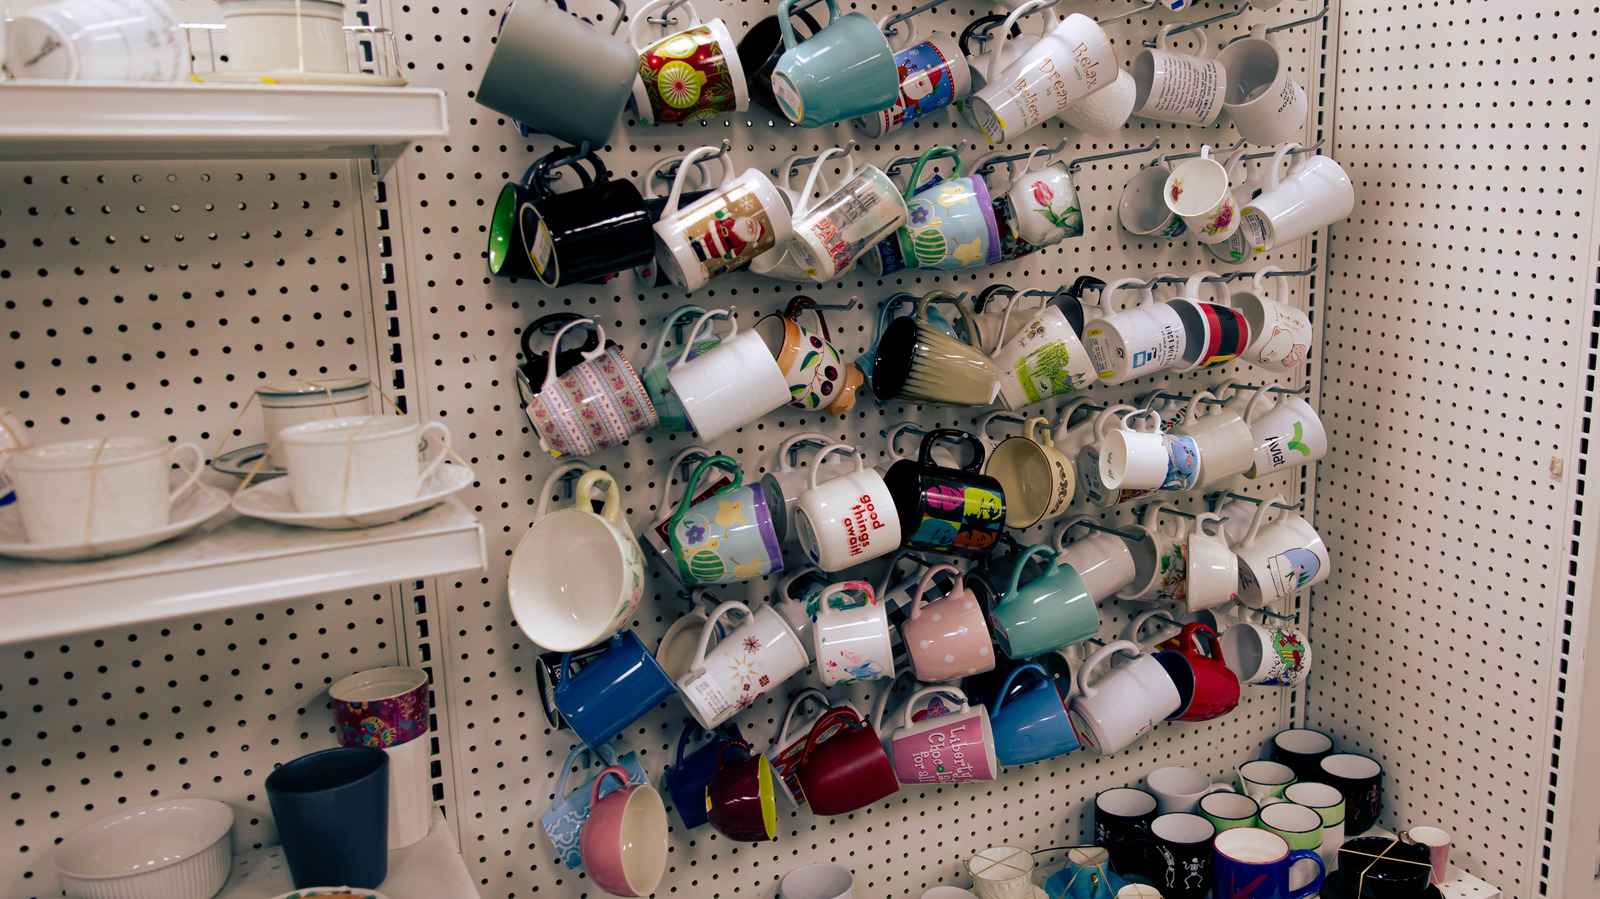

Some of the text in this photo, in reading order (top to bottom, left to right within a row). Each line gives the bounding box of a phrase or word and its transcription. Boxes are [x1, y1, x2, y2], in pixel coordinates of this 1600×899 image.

[1039, 58, 1068, 109] Dream
[1072, 41, 1099, 89] Relax
[1013, 78, 1039, 124] Believe
[1264, 436, 1286, 467] Aviat
[851, 504, 870, 548] things
[859, 494, 886, 530] good
[842, 518, 863, 557] await!
[912, 749, 937, 782] for all
[949, 724, 974, 780] Liberty
